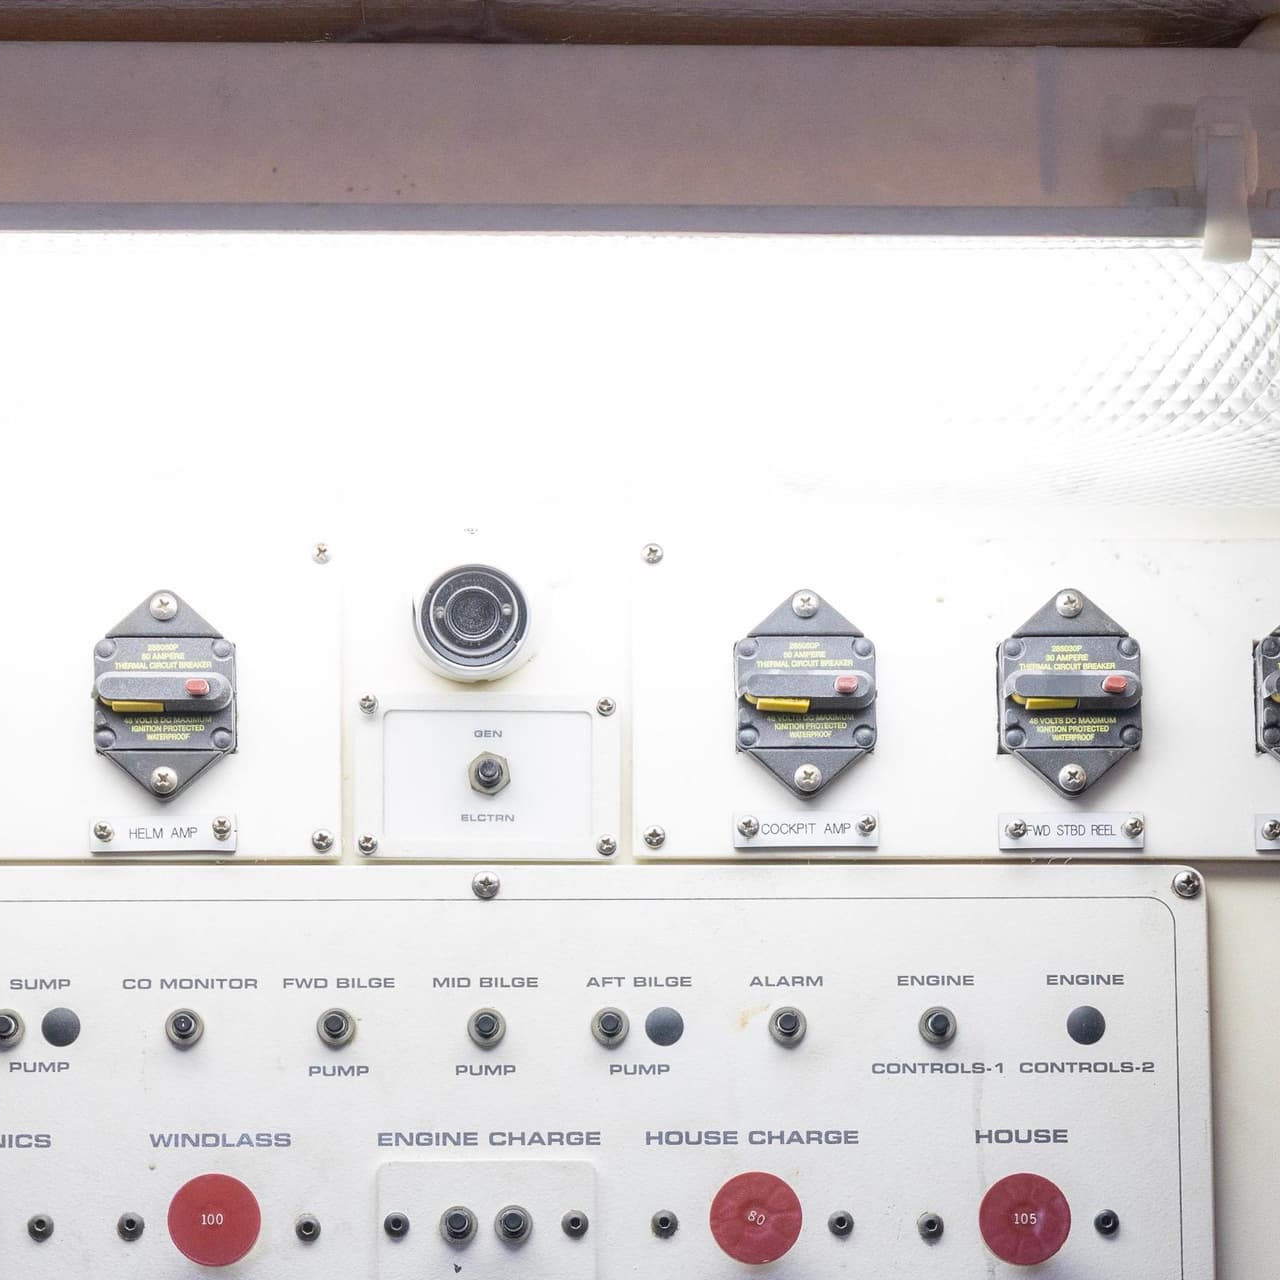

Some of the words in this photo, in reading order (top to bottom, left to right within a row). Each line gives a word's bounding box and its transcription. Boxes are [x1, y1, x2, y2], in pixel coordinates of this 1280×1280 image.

[152, 652, 186, 660] AMPERE
[794, 650, 827, 659] AMPERE
[1056, 654, 1089, 662] AMPERE
[114, 662, 148, 670] THERMAL
[148, 662, 179, 670] CIRCUIT
[180, 662, 212, 670] BREAKER
[756, 660, 790, 668] THERMAL
[790, 660, 819, 668] CIRCUIT
[820, 660, 854, 668] BREAKER
[1018, 662, 1052, 670] THERMAL
[1054, 662, 1082, 670] CIRCUIT
[1082, 662, 1116, 670] BREAKER
[774, 722, 805, 730] IGNITION
[806, 722, 848, 730] PROTECTED
[1036, 725, 1068, 733] IGNITION
[1068, 725, 1110, 733] PROTECTED
[146, 732, 190, 741] WATERPROOF
[473, 729, 503, 738] GEN
[788, 730, 832, 738] WATERPROOF
[460, 813, 515, 823] ELCTRN
[128, 827, 164, 840] HELM
[170, 826, 198, 839] AMP
[760, 823, 817, 835] COCKPIT
[824, 822, 852, 834] AMP
[1026, 824, 1051, 837] FWD
[1056, 824, 1086, 837] STBD
[1091, 824, 1116, 837] REEL
[9, 978, 71, 991] SUMP
[122, 978, 152, 990] CO
[159, 978, 258, 990] MONITOR
[282, 977, 328, 989] FWD
[336, 977, 396, 989] BILGE
[432, 977, 471, 989] MID
[479, 976, 539, 988] BILGE
[586, 976, 626, 988] AFT
[633, 976, 693, 988] BILGE
[749, 975, 824, 987] ALARM
[897, 975, 975, 987] ENGINE
[1046, 974, 1125, 986] ENGINE
[8, 1061, 70, 1073] PUMP
[308, 1065, 370, 1077] PUMP
[455, 1064, 516, 1076] PUMP
[609, 1063, 671, 1076] PUMP
[871, 1062, 1004, 1075] CONTROLS-1
[1019, 1061, 1155, 1074] CONTROLS-2
[149, 1132, 292, 1148] WINDLASS
[377, 1131, 479, 1147] ENGINE
[488, 1131, 601, 1147] CHARGE
[645, 1130, 739, 1146] HOUSE
[748, 1130, 860, 1145] CHARGE
[975, 1128, 1069, 1144] HOUSE
[199, 1212, 225, 1227] 100
[747, 1208, 766, 1227] 80
[1012, 1211, 1038, 1226] 105
